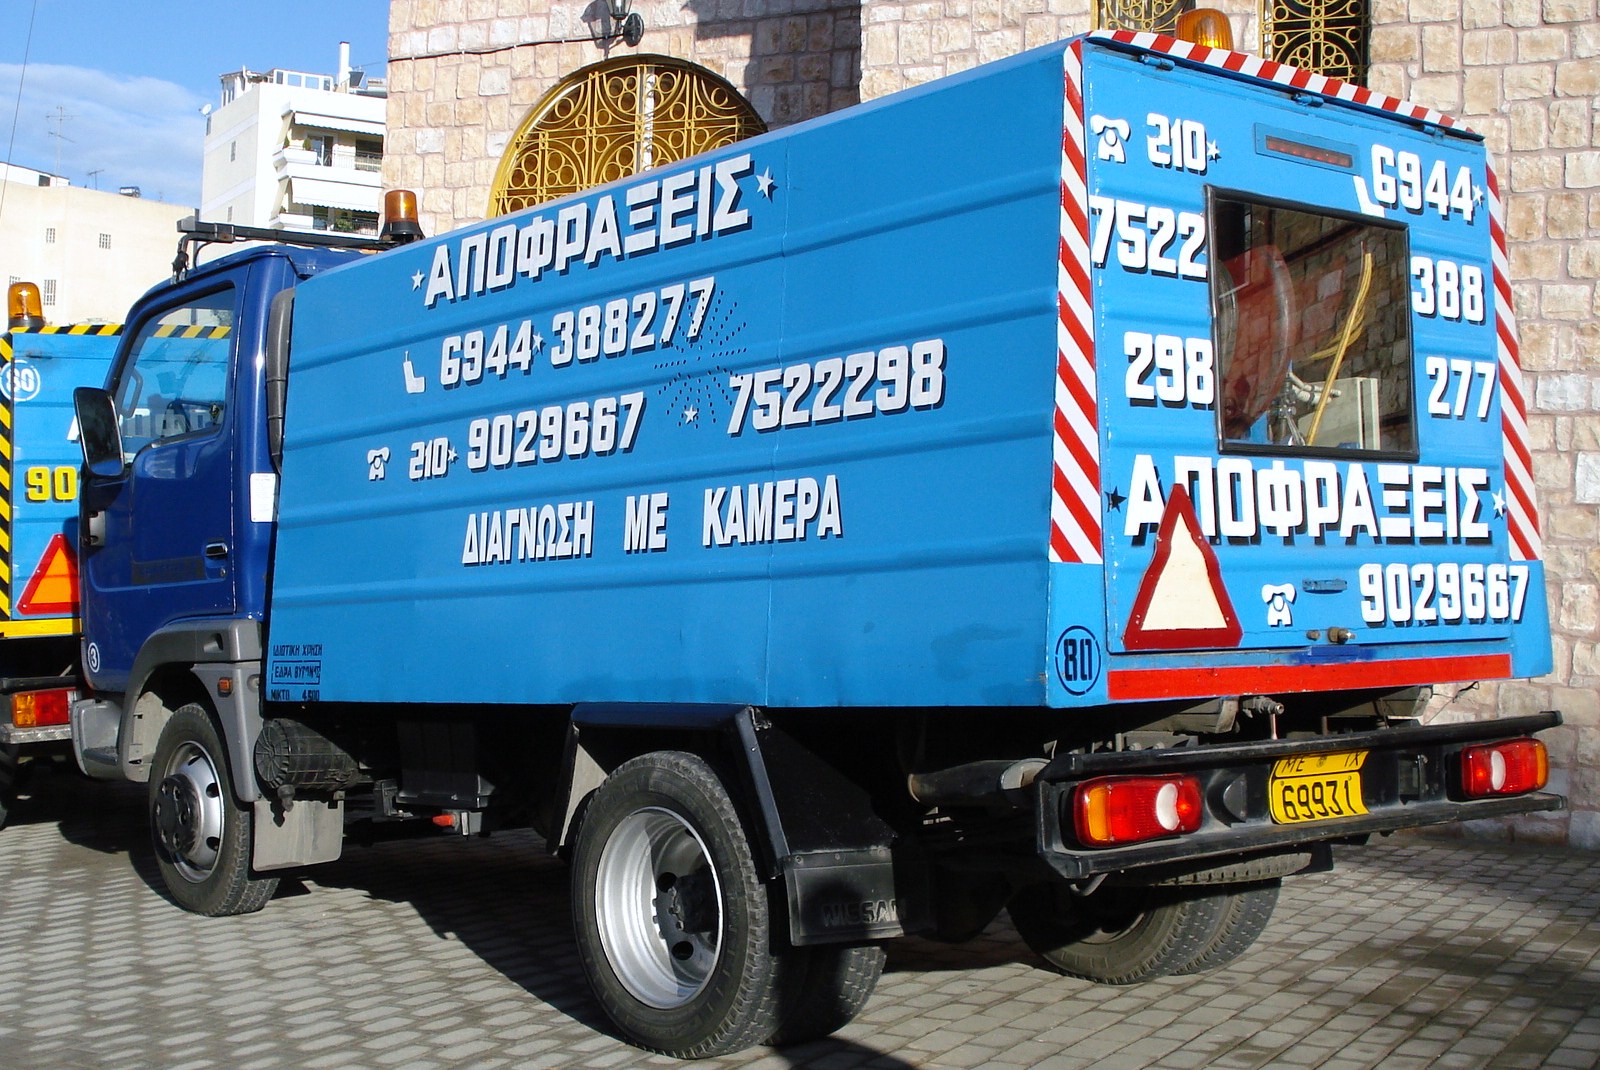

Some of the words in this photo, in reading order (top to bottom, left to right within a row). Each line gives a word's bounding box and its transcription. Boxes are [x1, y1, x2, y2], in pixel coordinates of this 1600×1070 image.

[1146, 112, 1206, 172] 210
[1371, 144, 1473, 222] 6944
[424, 153, 752, 308] ΑΠΟΦΡΑΞΕΙΣ
[1089, 195, 1208, 278] 7522
[1411, 256, 1484, 322] 388
[440, 319, 533, 386] 6944
[550, 276, 715, 366] 388277
[1124, 332, 1214, 405] 298
[1425, 357, 1496, 419] 277
[409, 437, 449, 480] 210
[467, 392, 644, 469] 9029667
[728, 338, 944, 434] 7522298
[461, 500, 594, 564] ΔΙΑΓΝΩΣΗ
[623, 492, 669, 551] ΜΕ
[702, 474, 842, 547] ΚΑΜΕΡΑ
[1124, 454, 1489, 539] ΑΠΟΦΡΑΞΕΙΣ
[1359, 563, 1529, 623] 9029667
[90, 649, 98, 667] 3
[1064, 639, 1092, 681] 80
[1282, 780, 1358, 821] 69931
